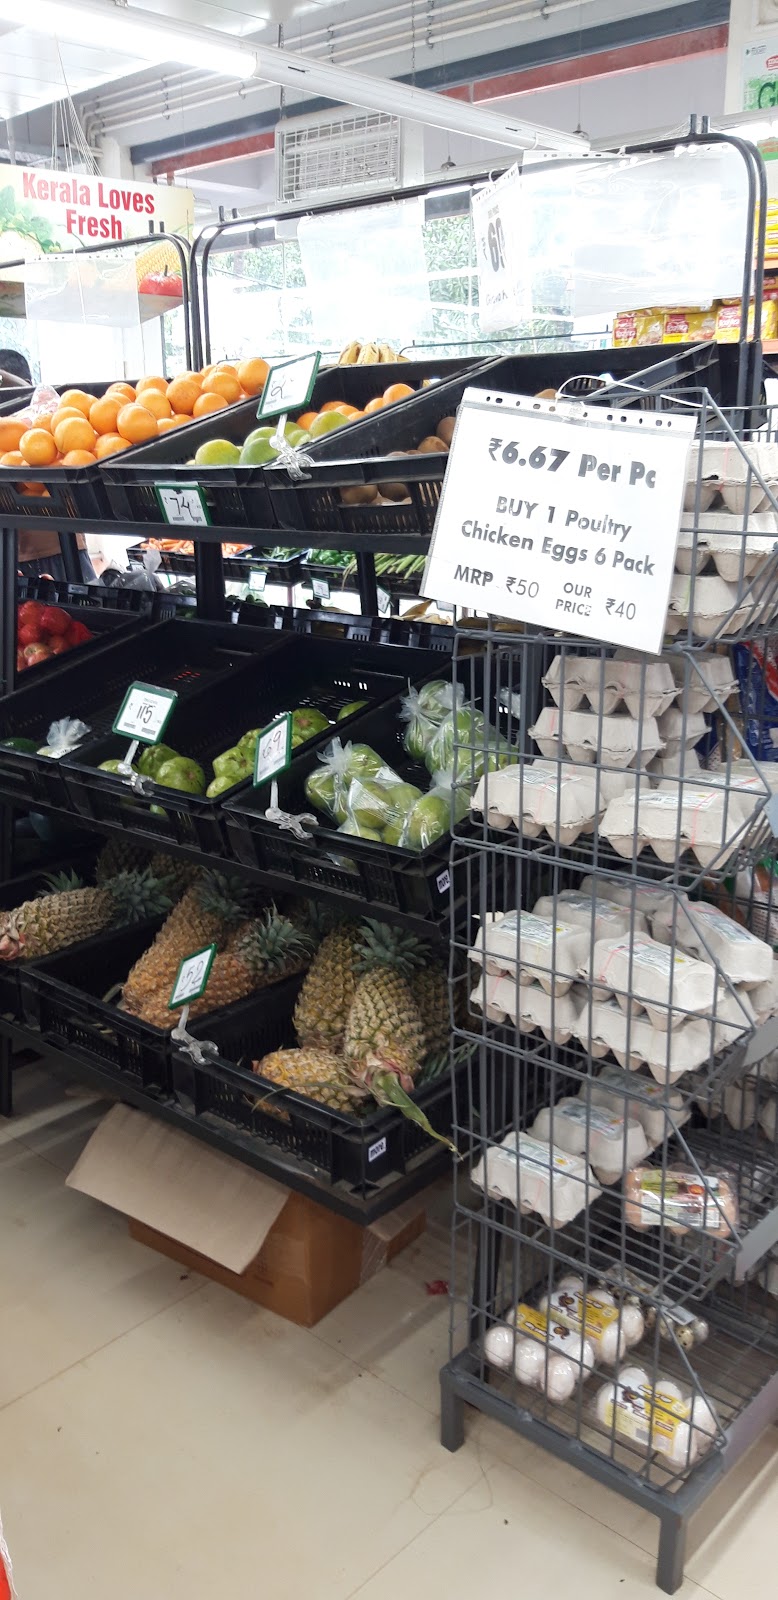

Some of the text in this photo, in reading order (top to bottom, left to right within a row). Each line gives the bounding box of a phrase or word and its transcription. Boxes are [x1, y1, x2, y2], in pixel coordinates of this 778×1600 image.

[23, 172, 155, 215] Kerala Loves
[66, 209, 123, 241] Fresh
[488, 437, 657, 489] ₹6.67 Per Pc
[496, 496, 632, 542] BUY 1 Poultry
[461, 520, 655, 576] Chicken Eggs 6 Pack
[454, 564, 540, 599] MRP ₹50
[563, 582, 592, 599] OUR
[555, 598, 592, 617] PRICE
[605, 596, 637, 621] ₹40
